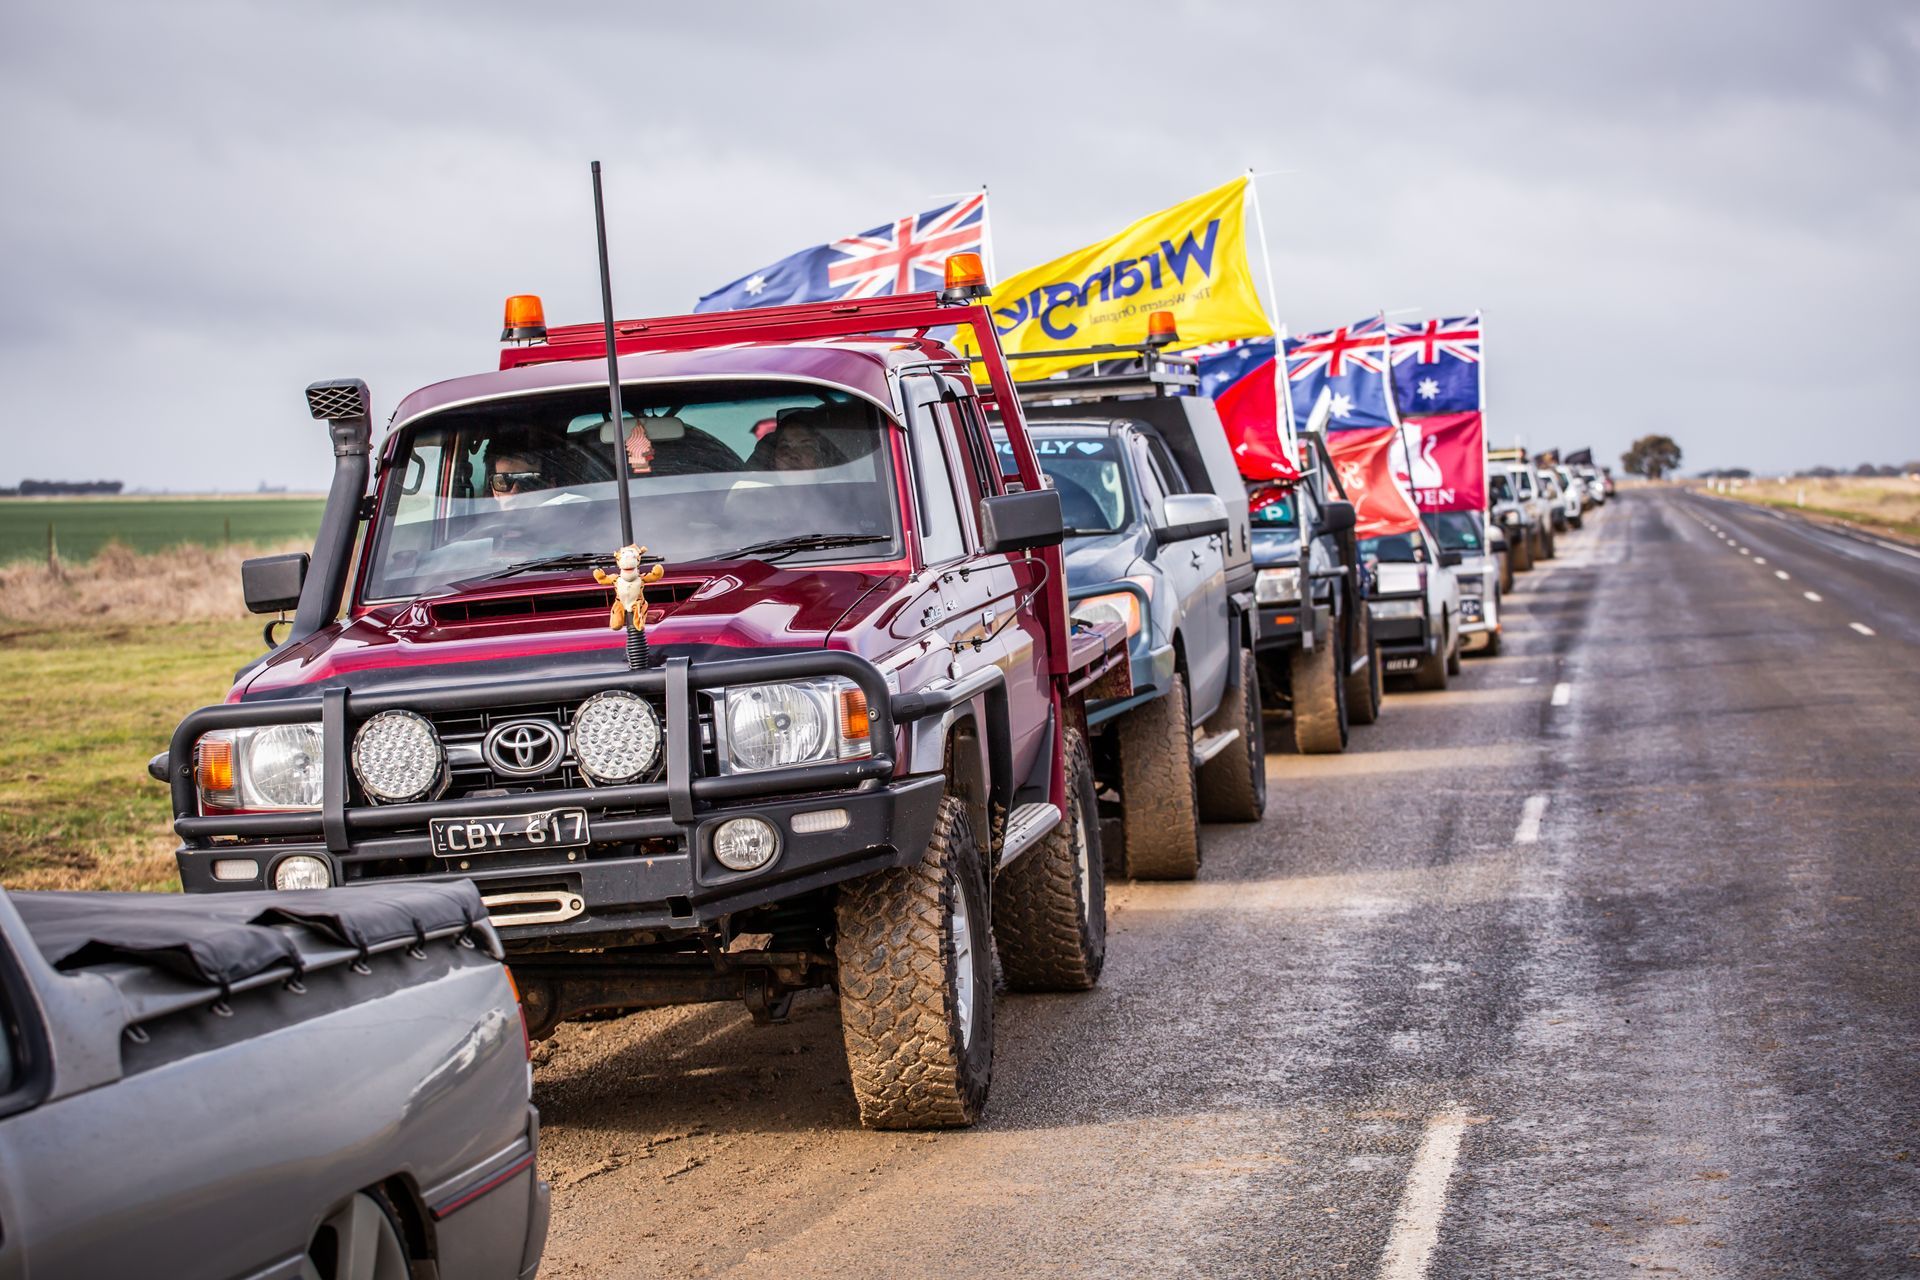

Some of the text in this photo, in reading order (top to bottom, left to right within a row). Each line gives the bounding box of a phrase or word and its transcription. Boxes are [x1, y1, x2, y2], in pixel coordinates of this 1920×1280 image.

[994, 441, 1074, 455] DOLY
[1409, 488, 1455, 505] DEN
[435, 824, 448, 851] VIC
[447, 812, 583, 851] CBY 617
